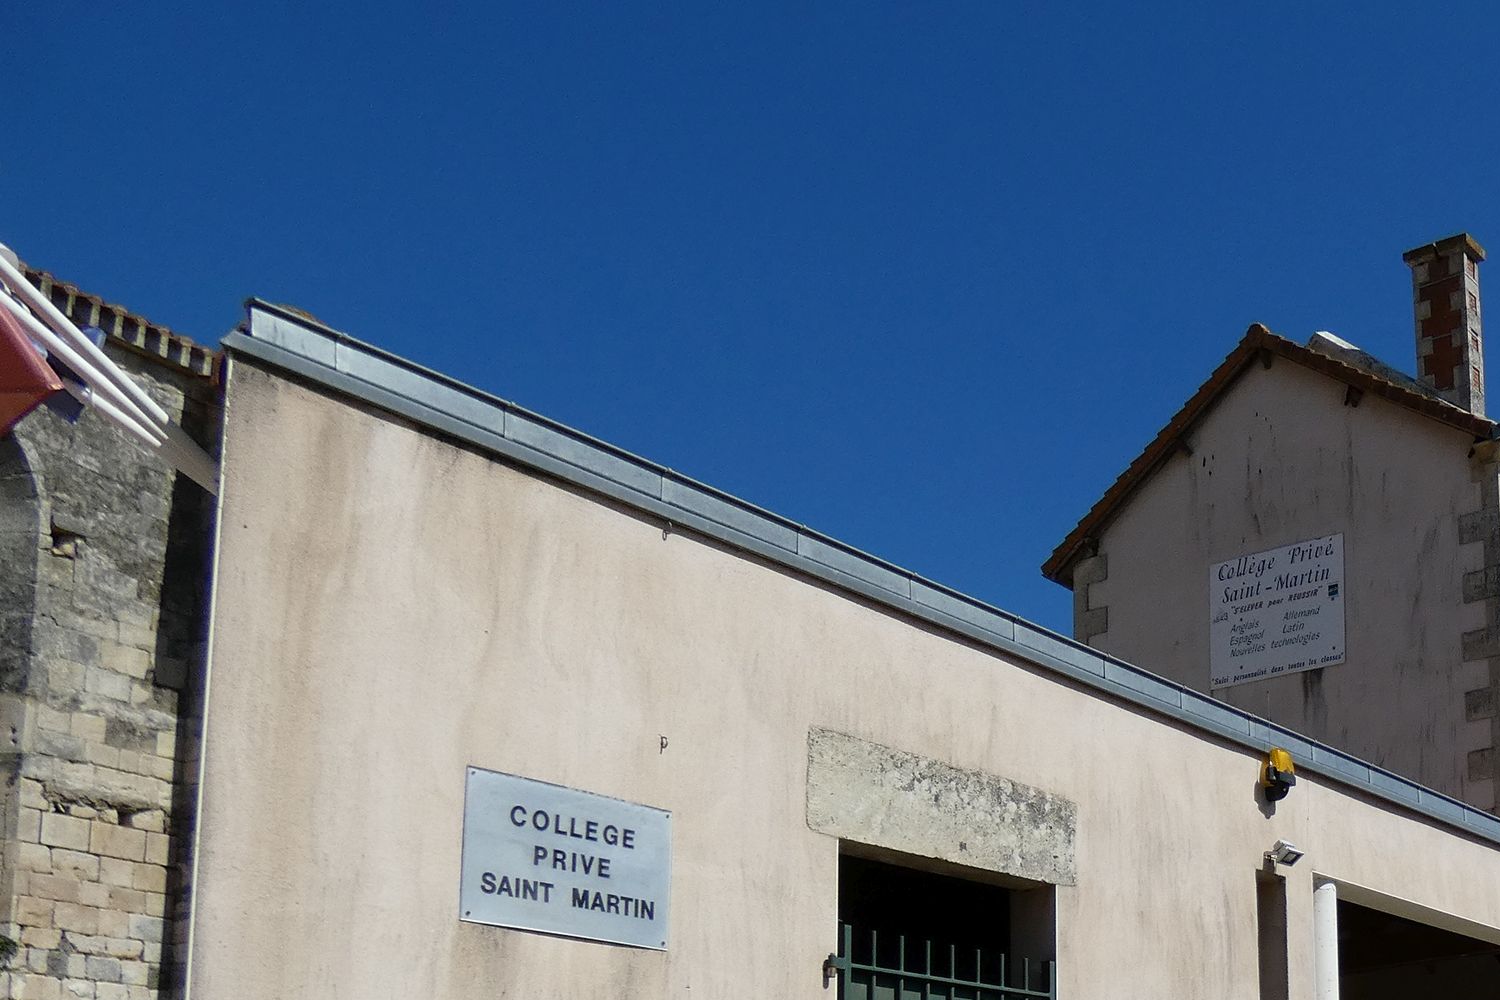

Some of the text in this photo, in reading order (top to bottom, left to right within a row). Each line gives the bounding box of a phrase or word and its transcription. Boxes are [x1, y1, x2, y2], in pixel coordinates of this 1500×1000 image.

[1218, 537, 1334, 582] Collège Privé
[1283, 605, 1321, 621] Allemand
[1229, 629, 1265, 647] Espagnol
[1230, 619, 1260, 635] Anglais
[1282, 620, 1305, 634] Latin
[1229, 631, 1321, 658] Nouvelles technologies
[510, 805, 636, 850] COLLEGE
[533, 845, 611, 879] PRIVE
[480, 872, 655, 920] SAINT MARTIN
